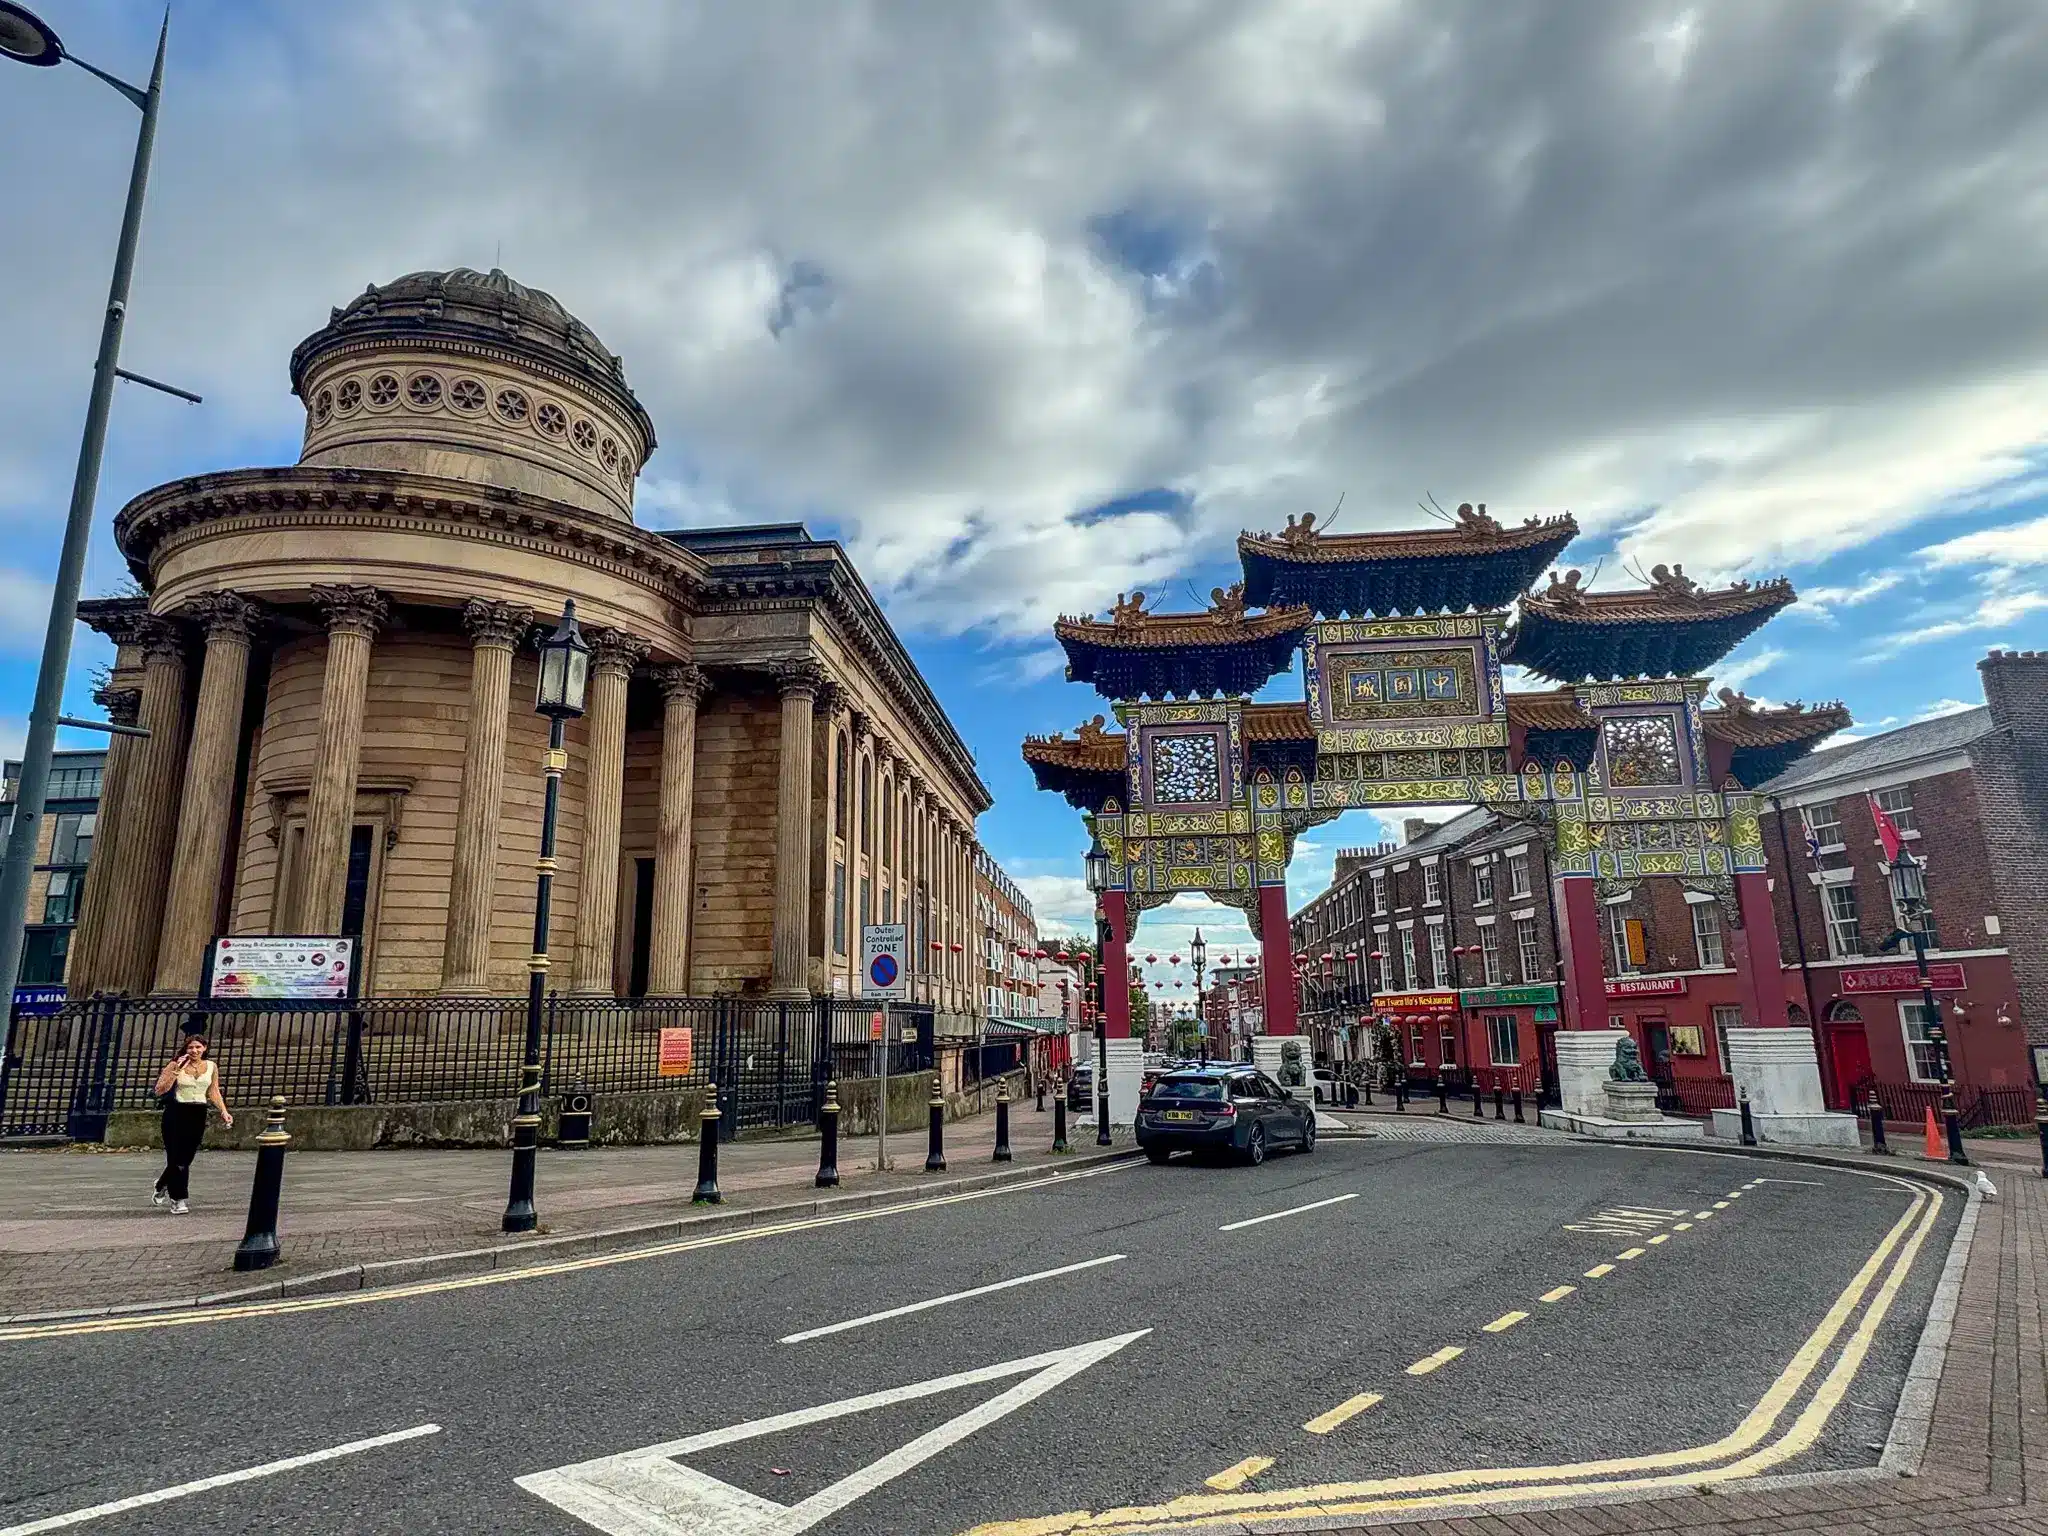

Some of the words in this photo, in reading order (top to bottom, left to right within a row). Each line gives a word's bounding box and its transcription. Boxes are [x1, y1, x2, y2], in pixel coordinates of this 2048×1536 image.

[865, 934, 904, 943] Controlled
[871, 944, 898, 952] ZONE
[1620, 980, 1675, 992] RESTAURANT
[36, 993, 67, 1002] MIN
[1419, 995, 1454, 1005] Restaurant
